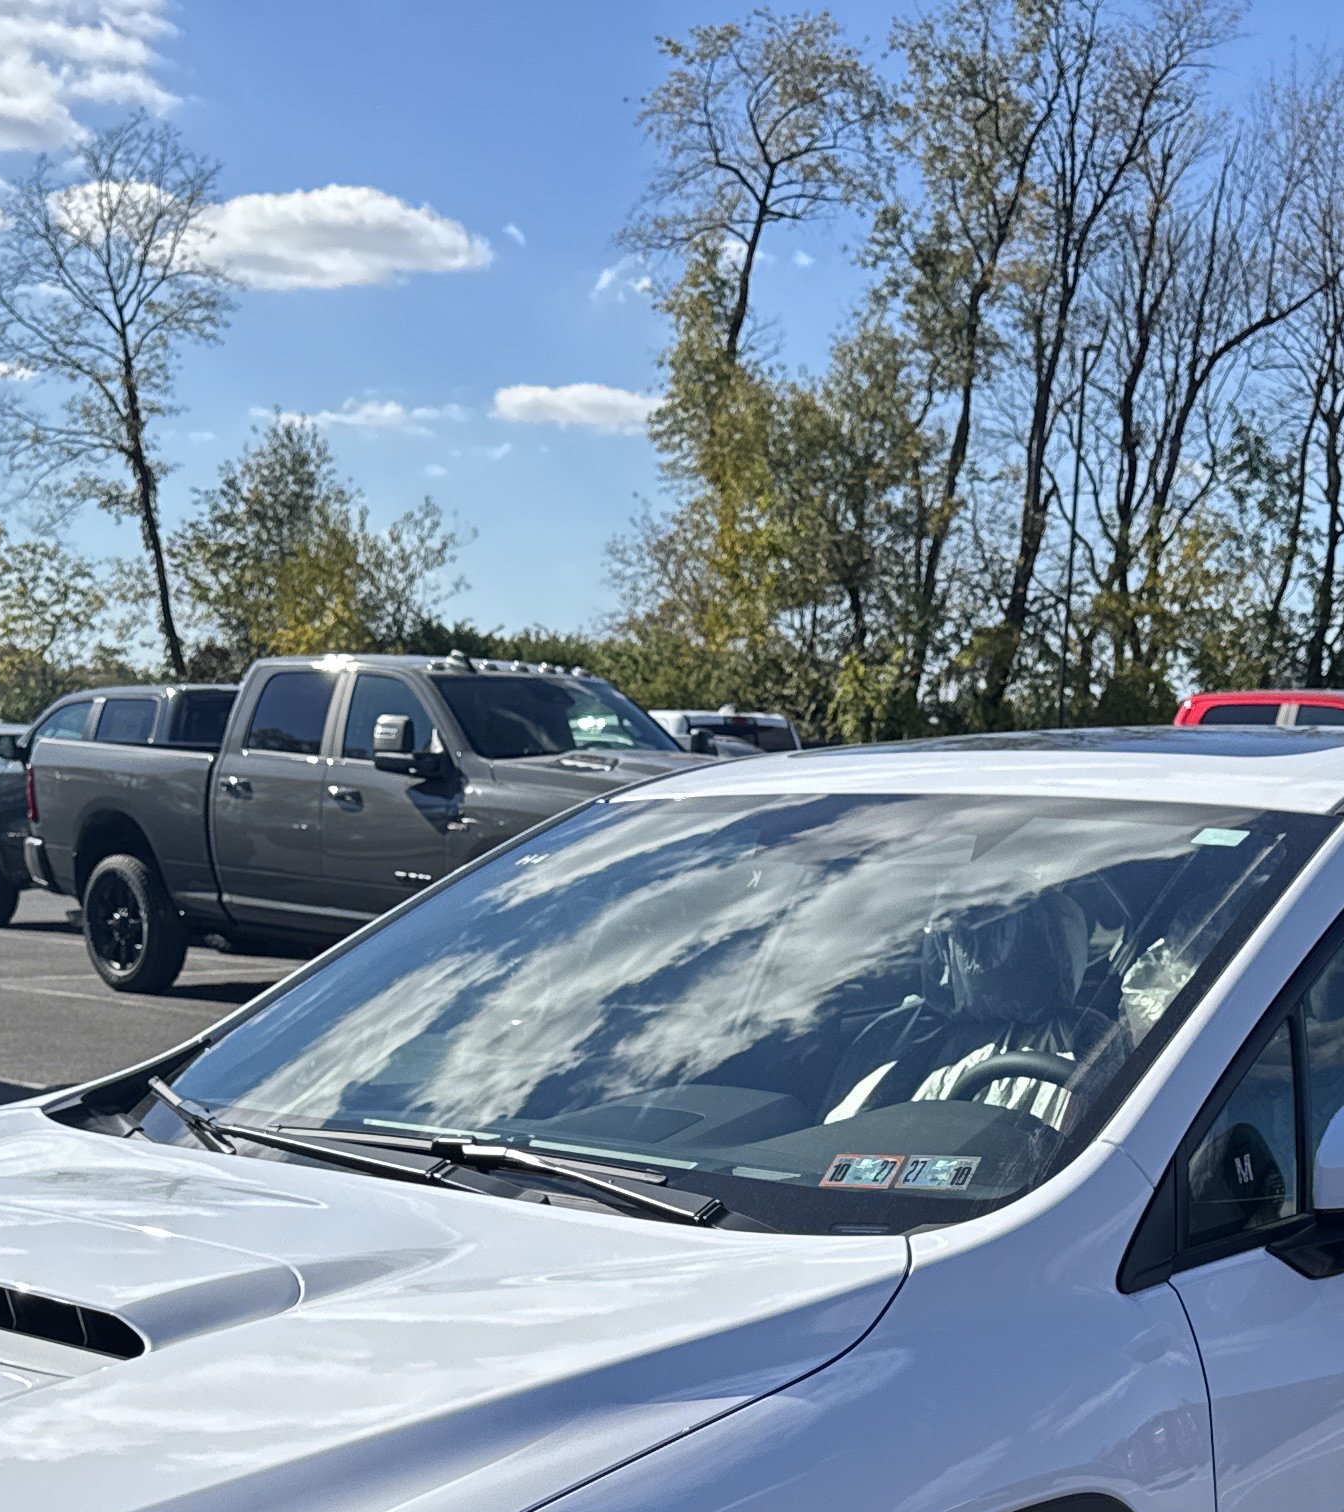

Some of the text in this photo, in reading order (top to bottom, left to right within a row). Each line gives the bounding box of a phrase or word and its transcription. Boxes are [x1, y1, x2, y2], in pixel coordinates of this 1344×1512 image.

[828, 1160, 897, 1184] 10 27
[903, 1160, 973, 1186] 27 10
